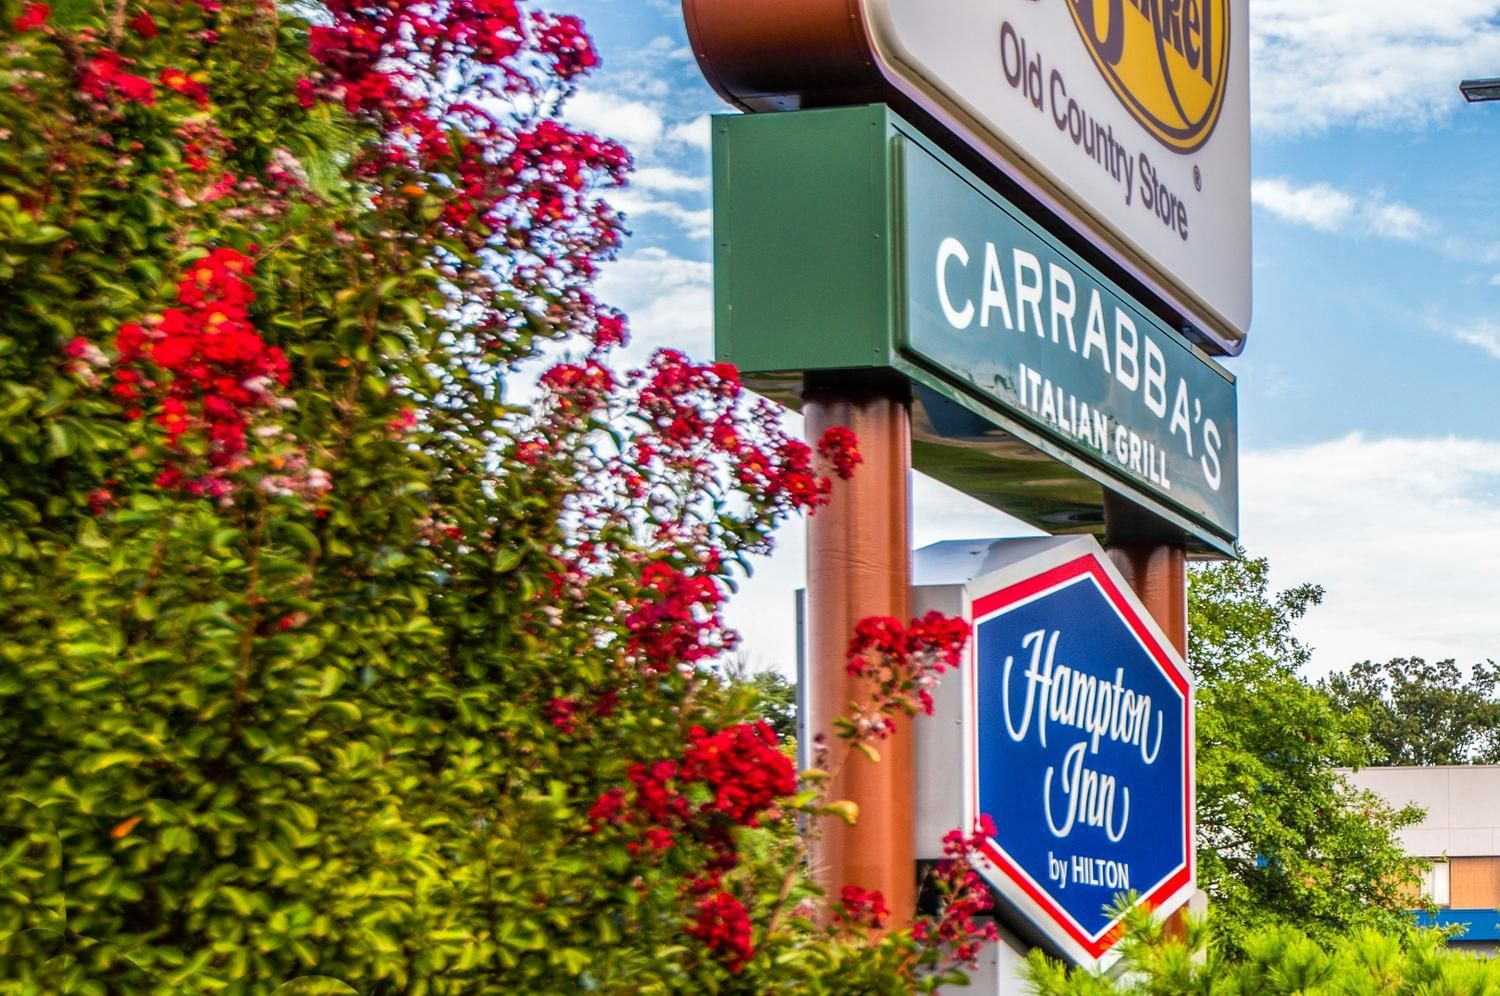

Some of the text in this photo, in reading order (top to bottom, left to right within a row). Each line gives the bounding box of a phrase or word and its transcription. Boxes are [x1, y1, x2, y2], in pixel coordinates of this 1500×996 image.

[1000, 21, 1188, 240] Old Country Store
[935, 237, 1222, 492] CARRABBA'S
[1018, 363, 1171, 490] ITALIAN GRILL
[1002, 628, 1163, 765] Hampton
[1043, 741, 1129, 843] Inn
[1048, 851, 1129, 890] by HILTON
